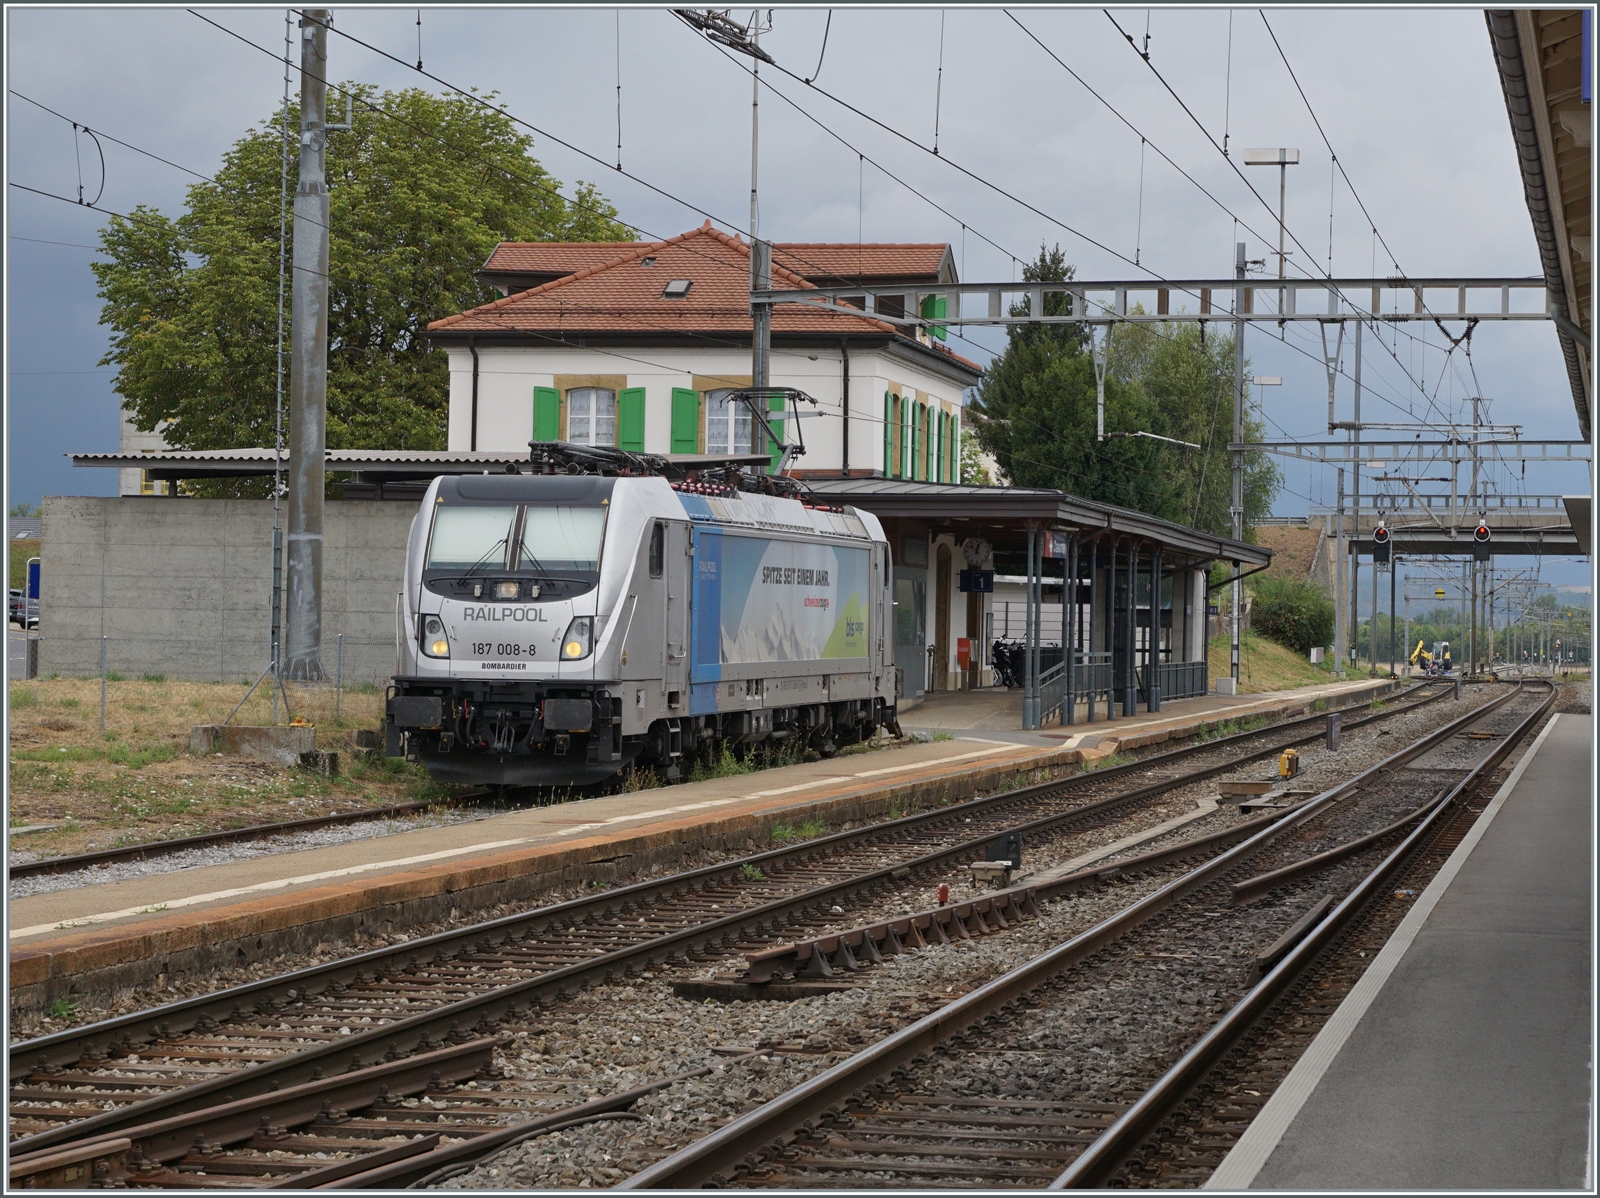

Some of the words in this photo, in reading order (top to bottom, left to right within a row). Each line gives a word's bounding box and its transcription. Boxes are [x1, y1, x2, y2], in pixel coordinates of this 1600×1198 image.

[762, 566, 782, 584] SPITZE
[783, 567, 796, 585] SEIT
[797, 568, 815, 586] EINEM
[979, 577, 984, 588] 1
[463, 607, 548, 622] RAILPOOL
[846, 616, 855, 637] bls
[472, 643, 492, 655] 187
[497, 643, 537, 656] 008-8
[481, 662, 527, 670] BOMBARDIER
